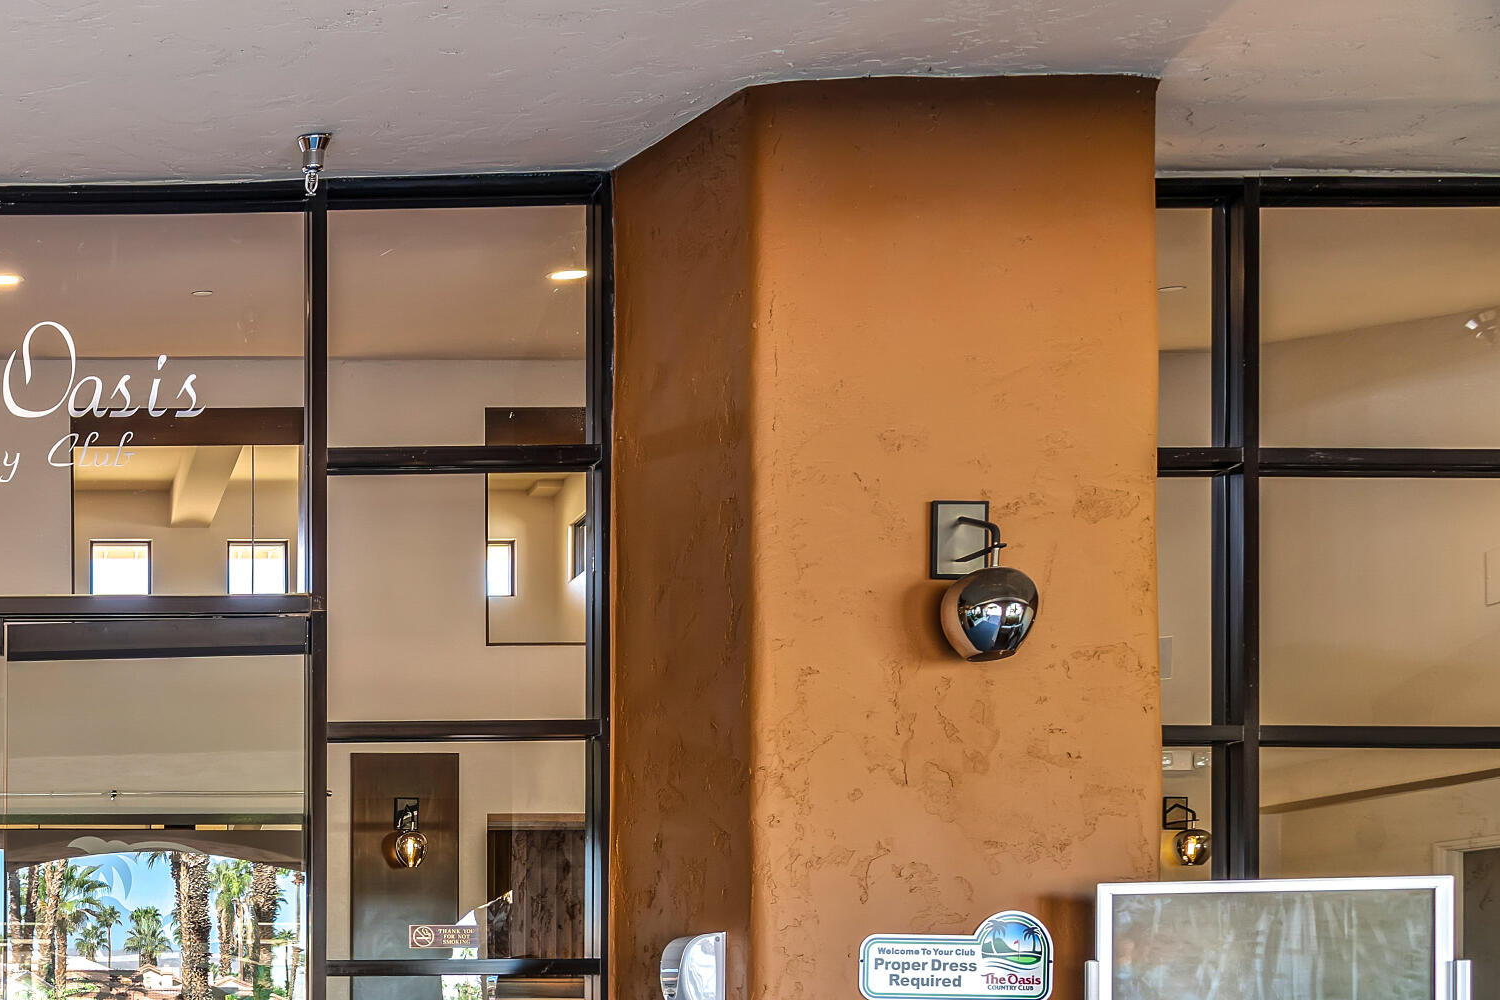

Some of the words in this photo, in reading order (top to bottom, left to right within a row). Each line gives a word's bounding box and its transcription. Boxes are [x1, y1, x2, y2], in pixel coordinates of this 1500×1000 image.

[2, 320, 207, 419] Oasis
[47, 431, 135, 468] Club
[877, 947, 920, 956] Welcome
[921, 948, 932, 956] To
[933, 948, 954, 956] Your
[955, 948, 976, 957] Club
[874, 957, 928, 974] Proper
[931, 958, 977, 972] Dress
[888, 973, 962, 989] Required
[981, 972, 1006, 984] The
[1007, 973, 1041, 985] Oasis
